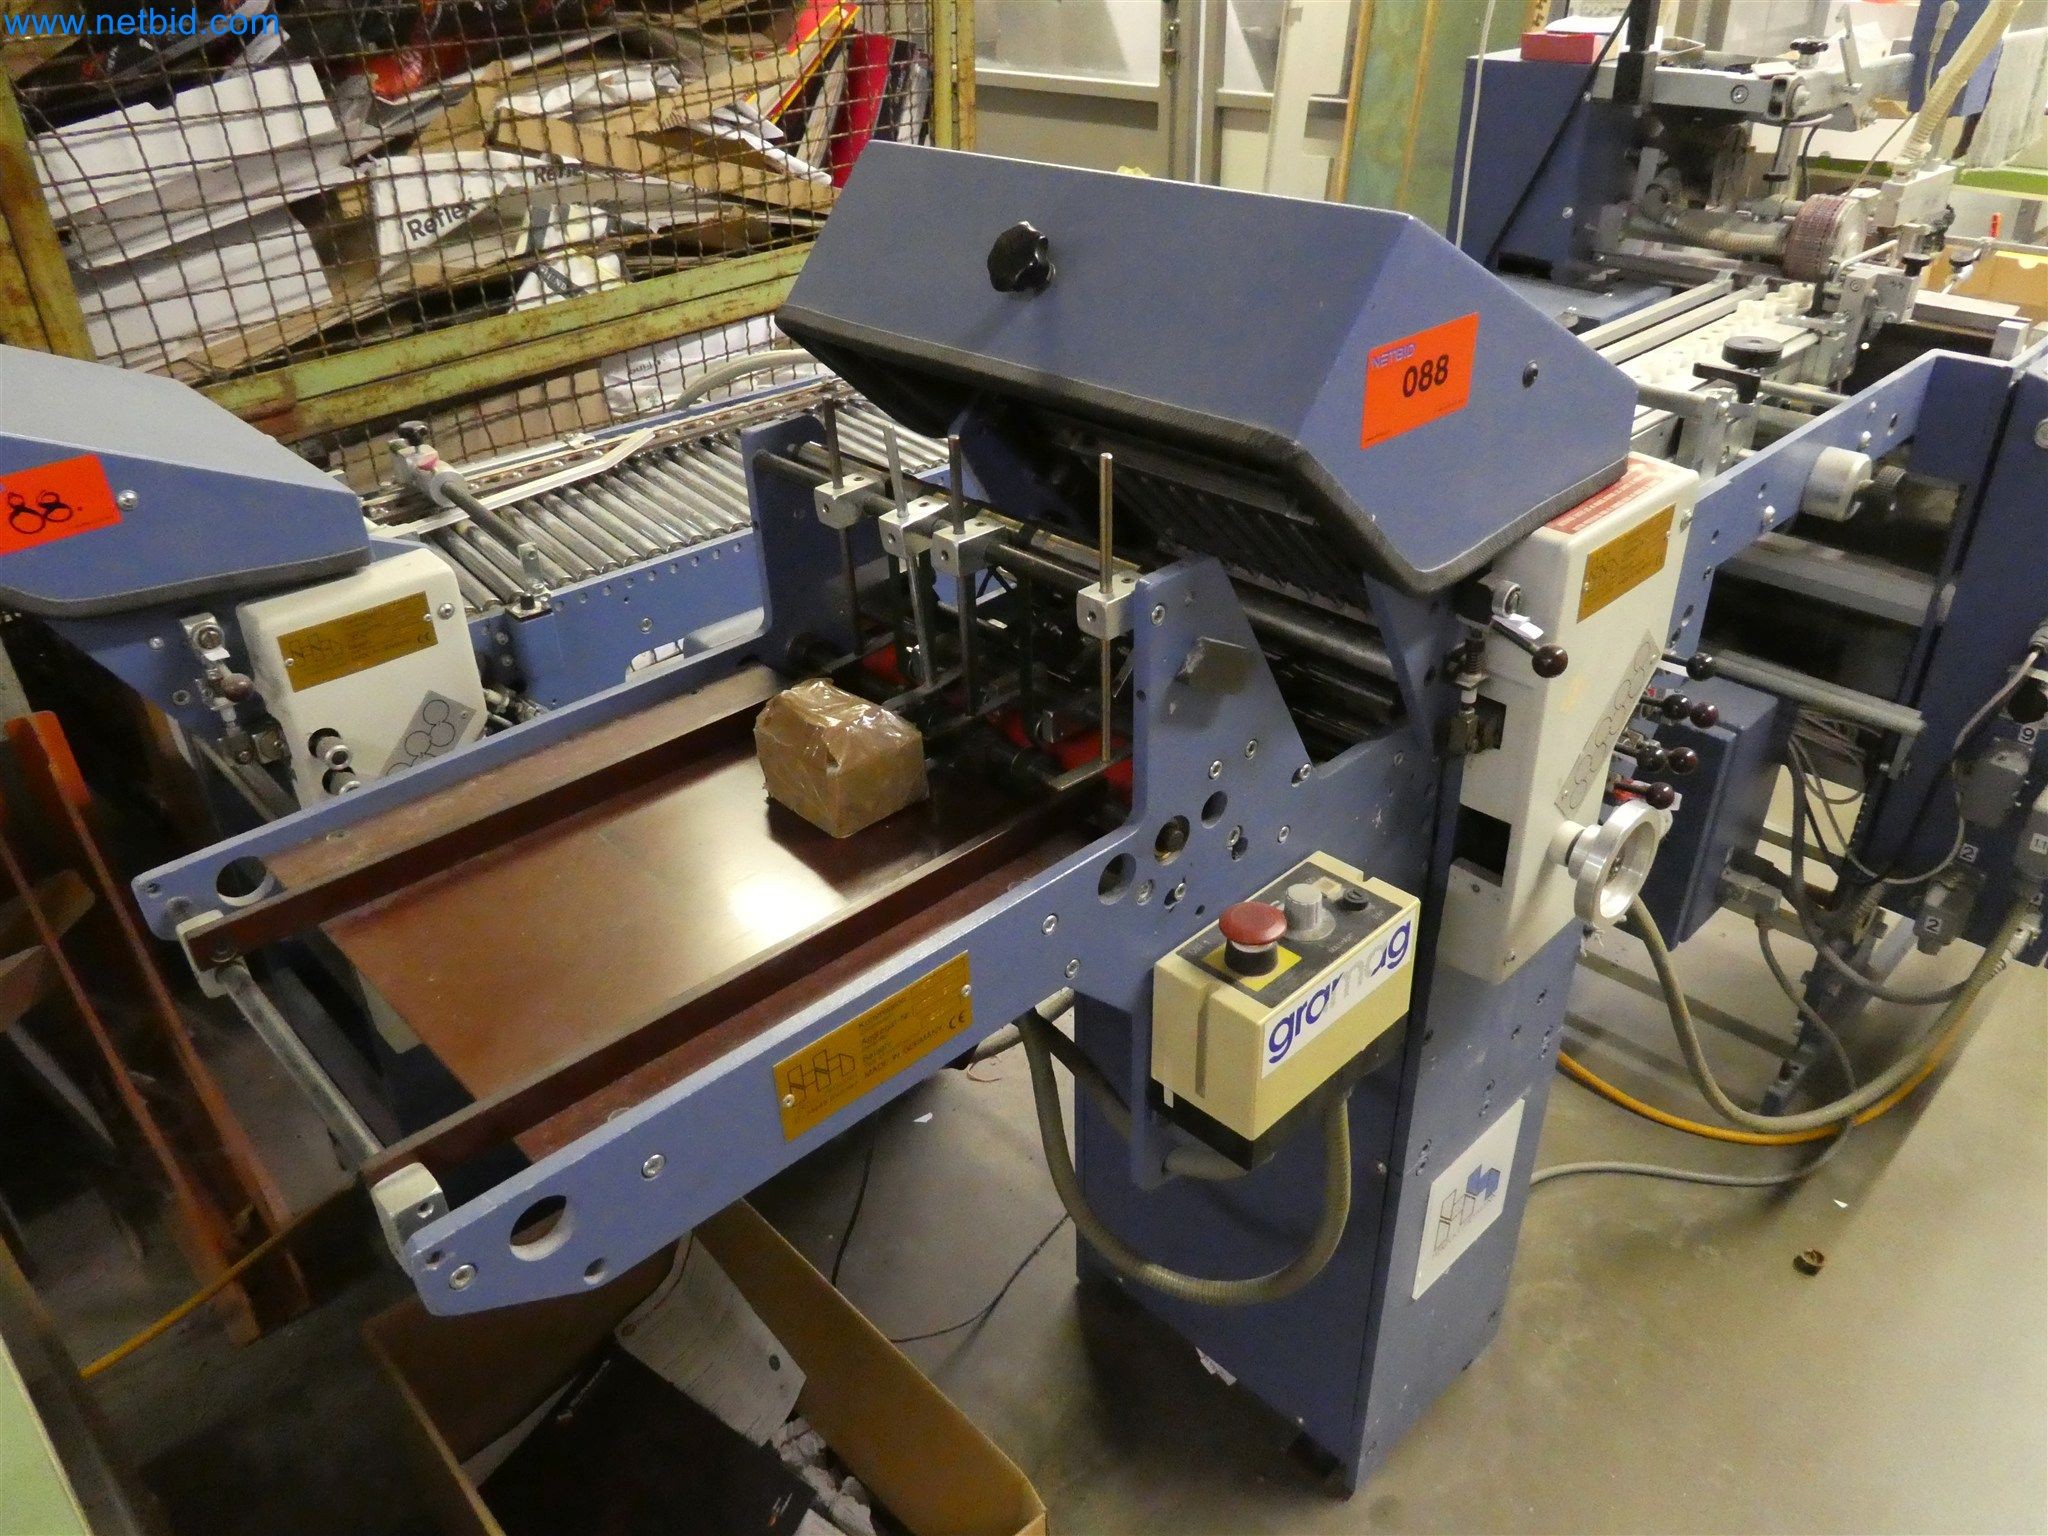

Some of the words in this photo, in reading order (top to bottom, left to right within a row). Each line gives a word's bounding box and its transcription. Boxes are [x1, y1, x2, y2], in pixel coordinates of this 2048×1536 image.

[406, 198, 477, 241] Reflex
[1402, 354, 1449, 398] 088
[2021, 727, 2035, 742] 9
[1962, 846, 1976, 860] 2
[1926, 919, 1940, 933] 2
